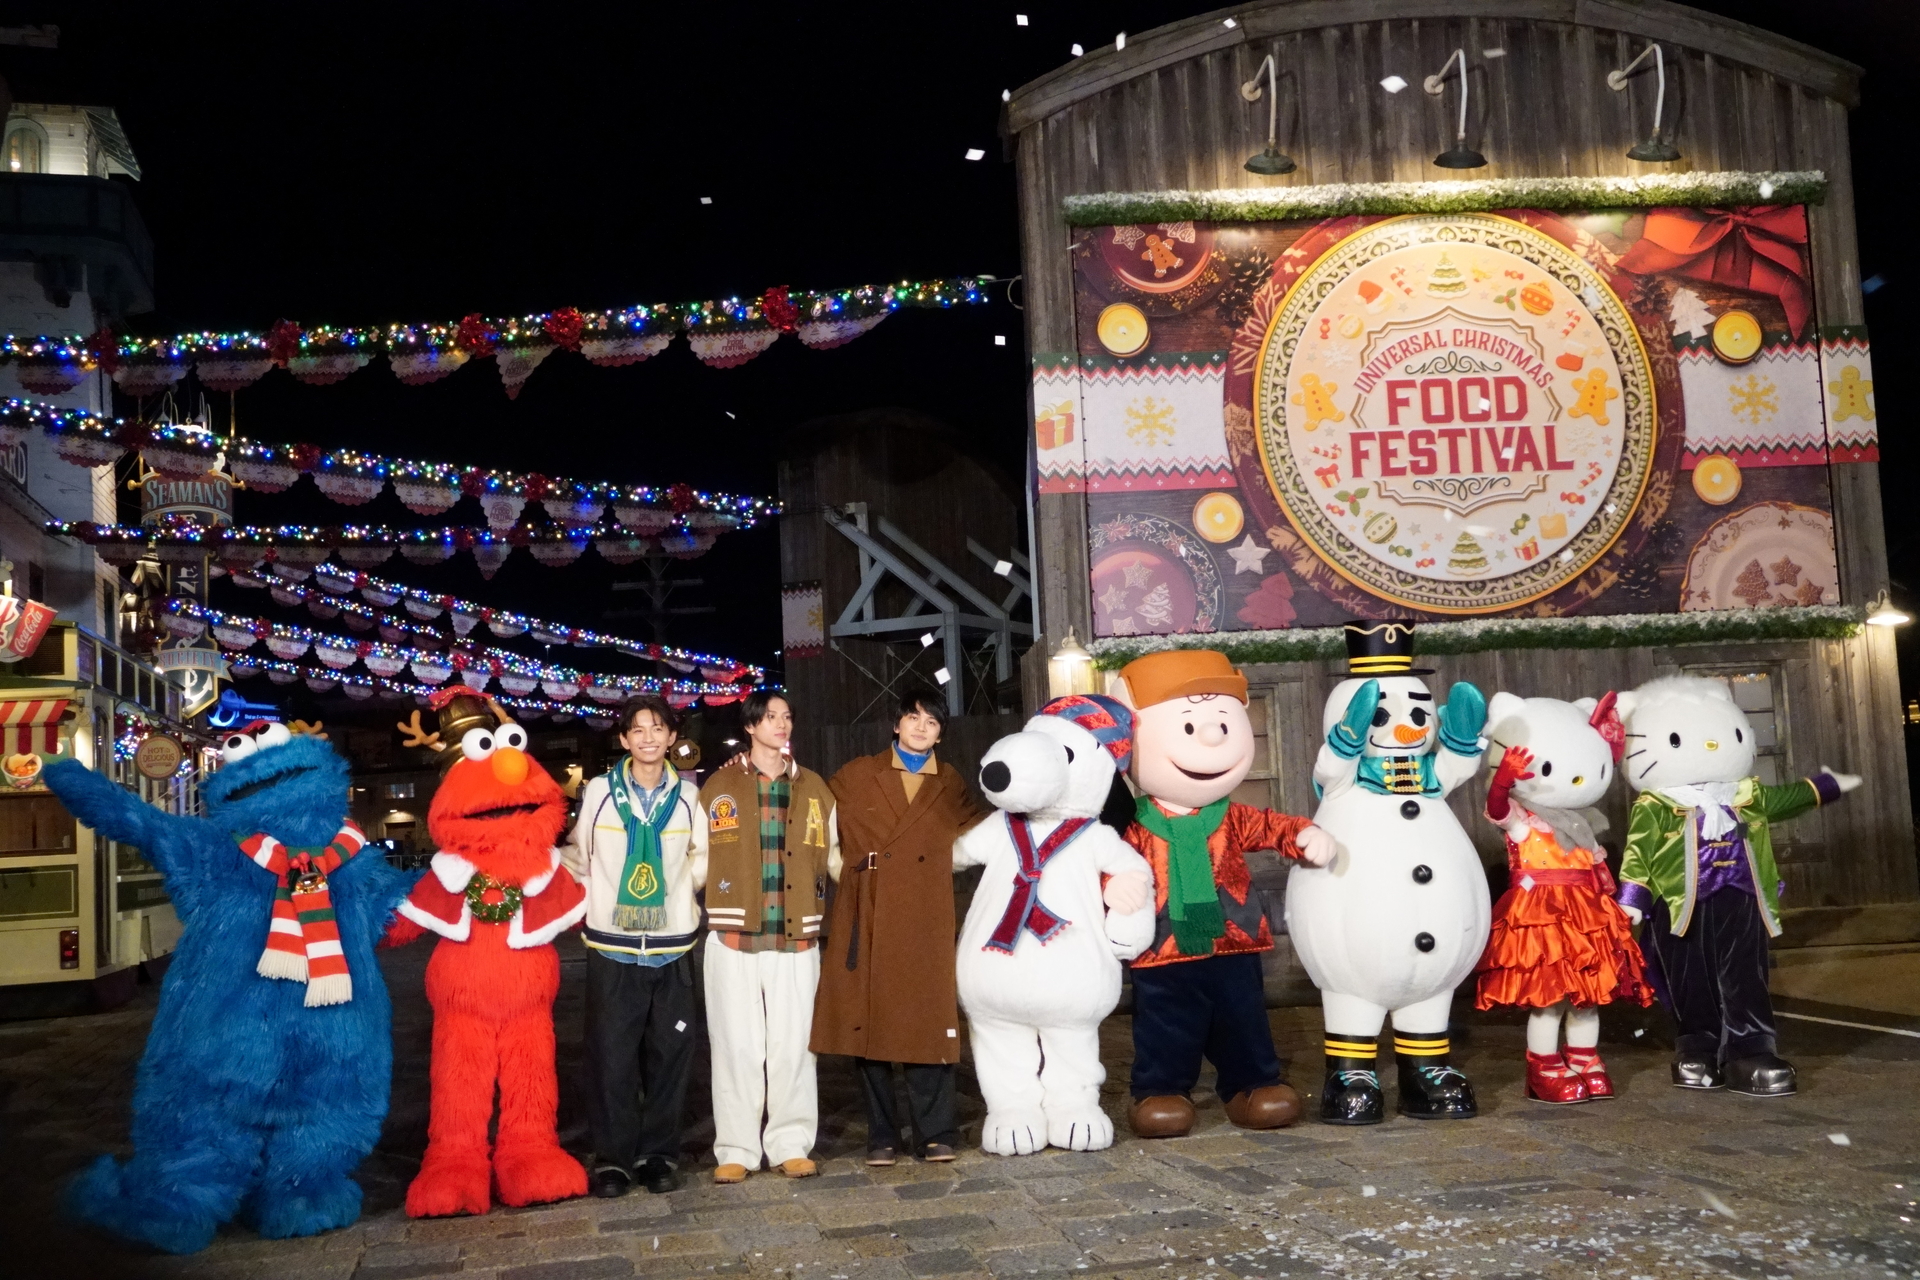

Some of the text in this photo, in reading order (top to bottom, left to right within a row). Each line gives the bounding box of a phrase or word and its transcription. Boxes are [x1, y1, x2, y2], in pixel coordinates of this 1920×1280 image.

[1353, 328, 1554, 394] UNIVERSAL CHRISTMAS
[1385, 376, 1528, 425] FOOD
[1349, 425, 1575, 478] FESTIVAL
[146, 480, 227, 510] SEAMAN'S
[160, 651, 216, 667] SOCIETY
[143, 753, 175, 762] DELICIOUS
[147, 746, 164, 754] HOT
[673, 748, 698, 760] SOP
[713, 818, 737, 829] LION
[802, 797, 825, 847] A
